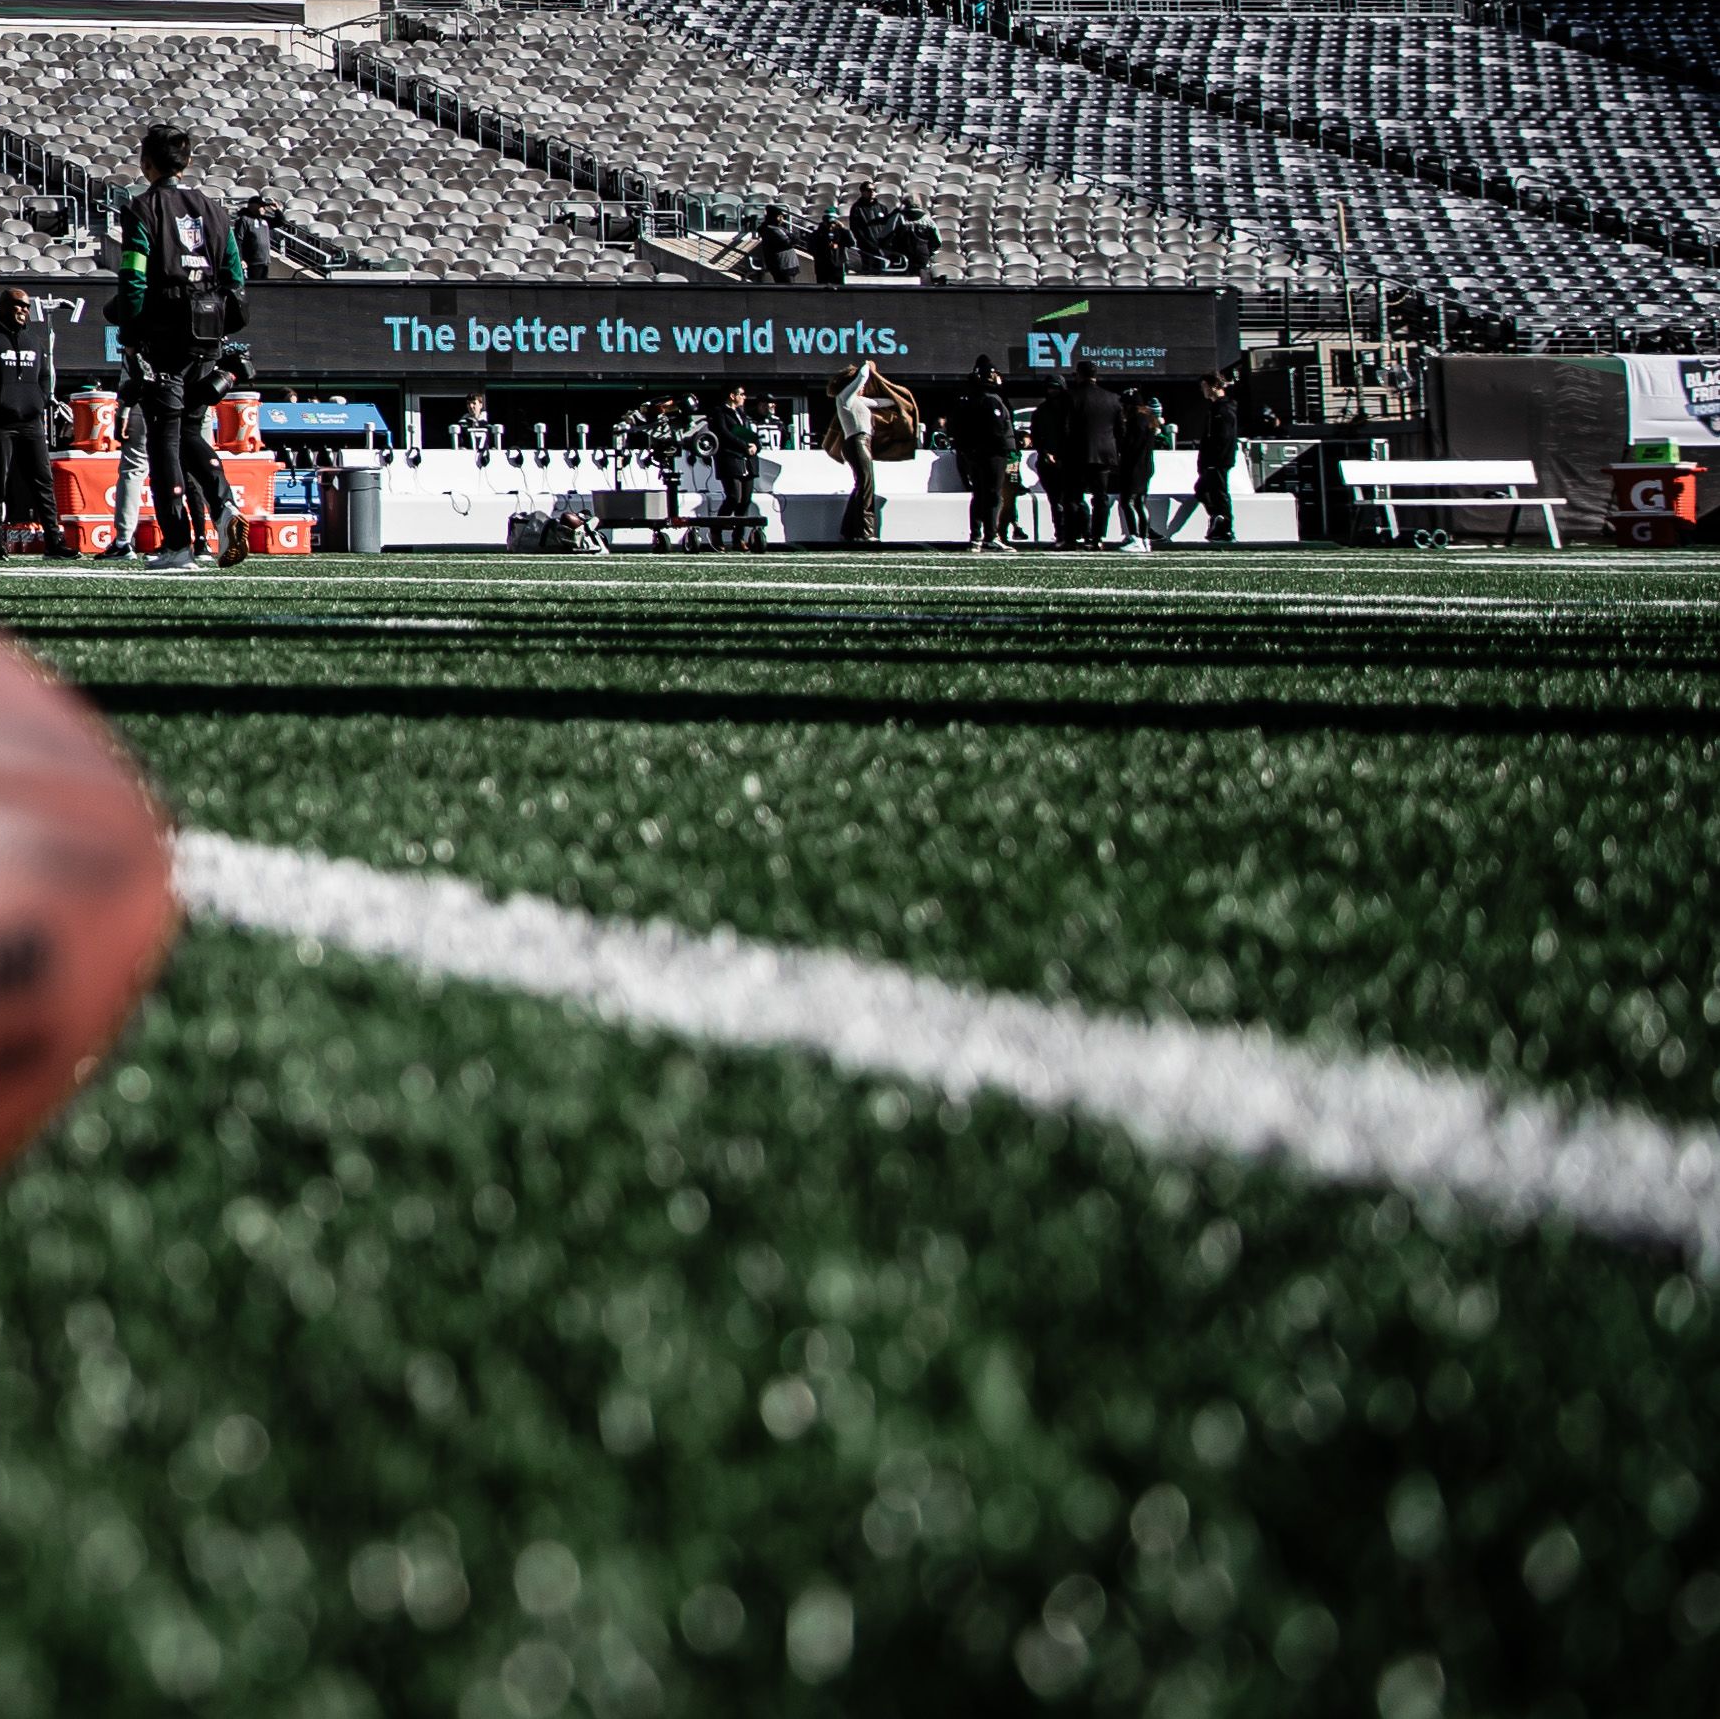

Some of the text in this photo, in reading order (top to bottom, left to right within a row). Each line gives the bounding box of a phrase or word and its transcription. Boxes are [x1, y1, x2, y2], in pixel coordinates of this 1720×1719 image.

[383, 316, 909, 355] The better the world works.
[1027, 332, 1081, 368] EY
[1685, 369, 1720, 388] BLAC
[96, 405, 115, 425] G
[243, 405, 259, 426] G
[757, 429, 782, 450] 20
[1630, 479, 1666, 512] G
[91, 525, 113, 549] G
[278, 524, 299, 548] G
[1631, 521, 1652, 542] G
